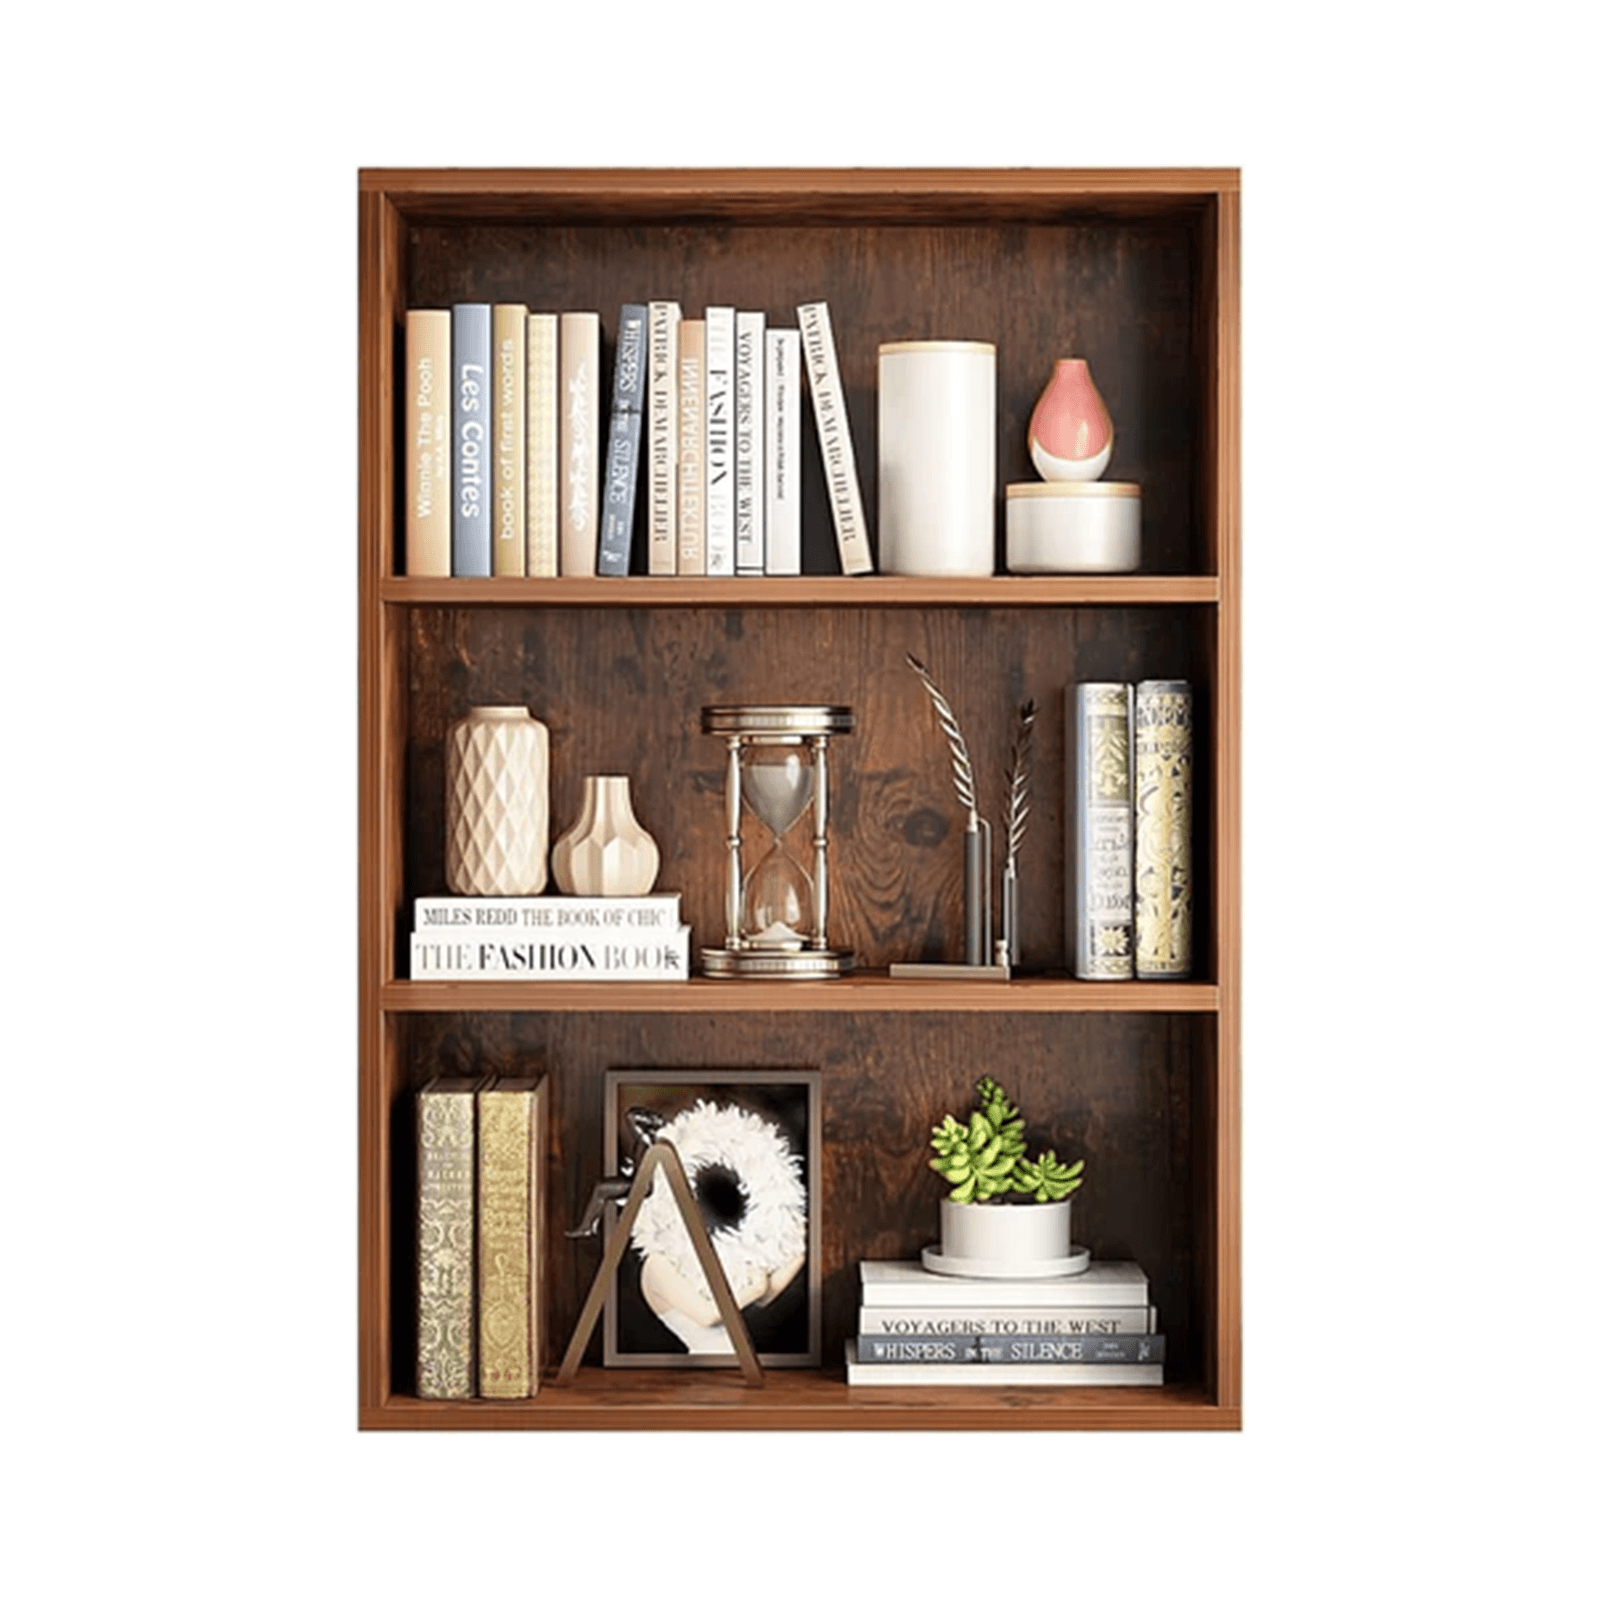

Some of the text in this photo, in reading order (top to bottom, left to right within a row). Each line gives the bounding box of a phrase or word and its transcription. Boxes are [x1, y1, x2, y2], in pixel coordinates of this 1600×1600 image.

[619, 319, 642, 392] WHISPERS
[417, 357, 433, 518] Winnie The Pooh
[461, 364, 484, 518] Les Contes
[500, 339, 514, 539] book of first words
[610, 438, 631, 504] SILENCE
[654, 303, 668, 542] PATRICK DEMARCHELIER
[709, 369, 727, 485] FASHION
[738, 331, 753, 543] VOYAGERS TO THE WEST
[803, 306, 856, 543] PATRICK DEMARCHELIER
[416, 944, 681, 970] THE FASHION BOOK
[423, 908, 666, 926] MILES REDD THE BOOK OF CHIC
[873, 1341, 956, 1360] WHISPERS
[1010, 1341, 1083, 1360] SILENCE
[881, 1319, 1121, 1334] VOYAGERS TO THE WEST
